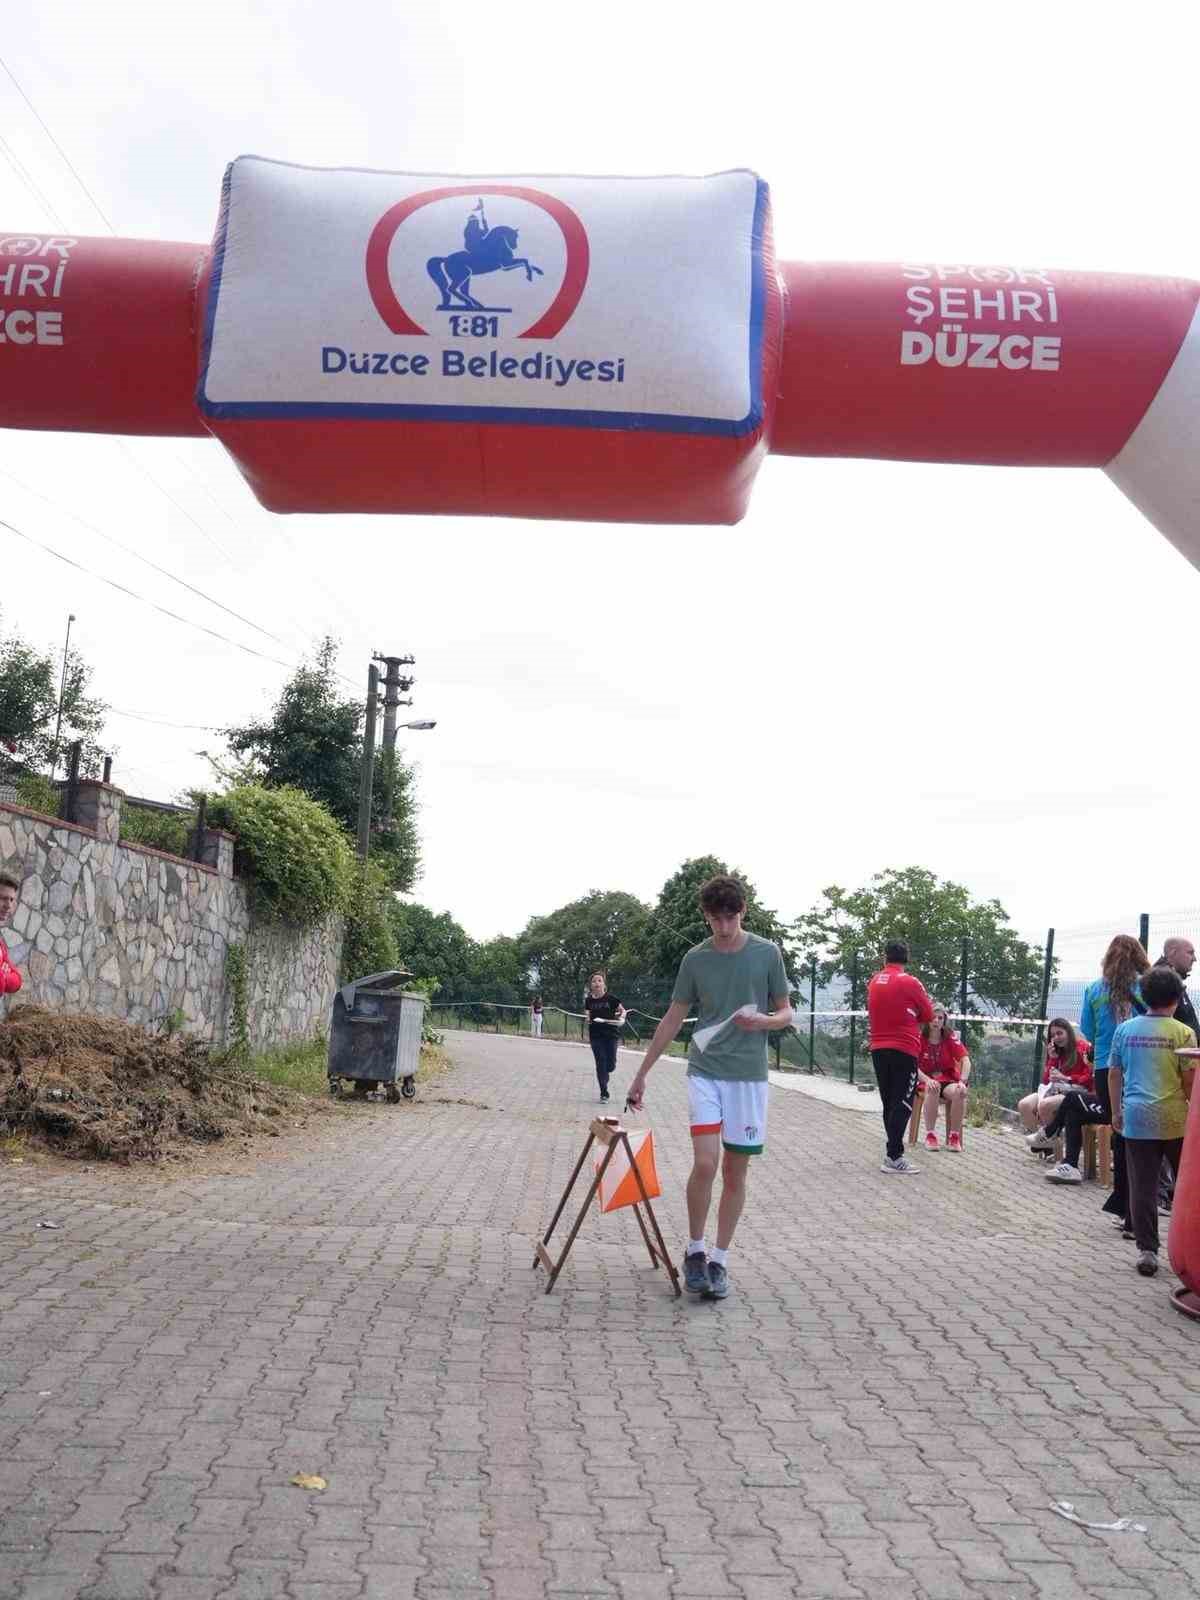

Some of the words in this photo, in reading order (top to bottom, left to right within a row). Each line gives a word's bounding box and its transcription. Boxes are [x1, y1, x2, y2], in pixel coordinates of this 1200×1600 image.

[905, 286, 1059, 325] ŞEHRİ
[0, 309, 64, 346] CE
[322, 347, 430, 376] Düzce
[442, 350, 625, 387] Belediyesi
[900, 324, 1062, 371] DÜZCE
